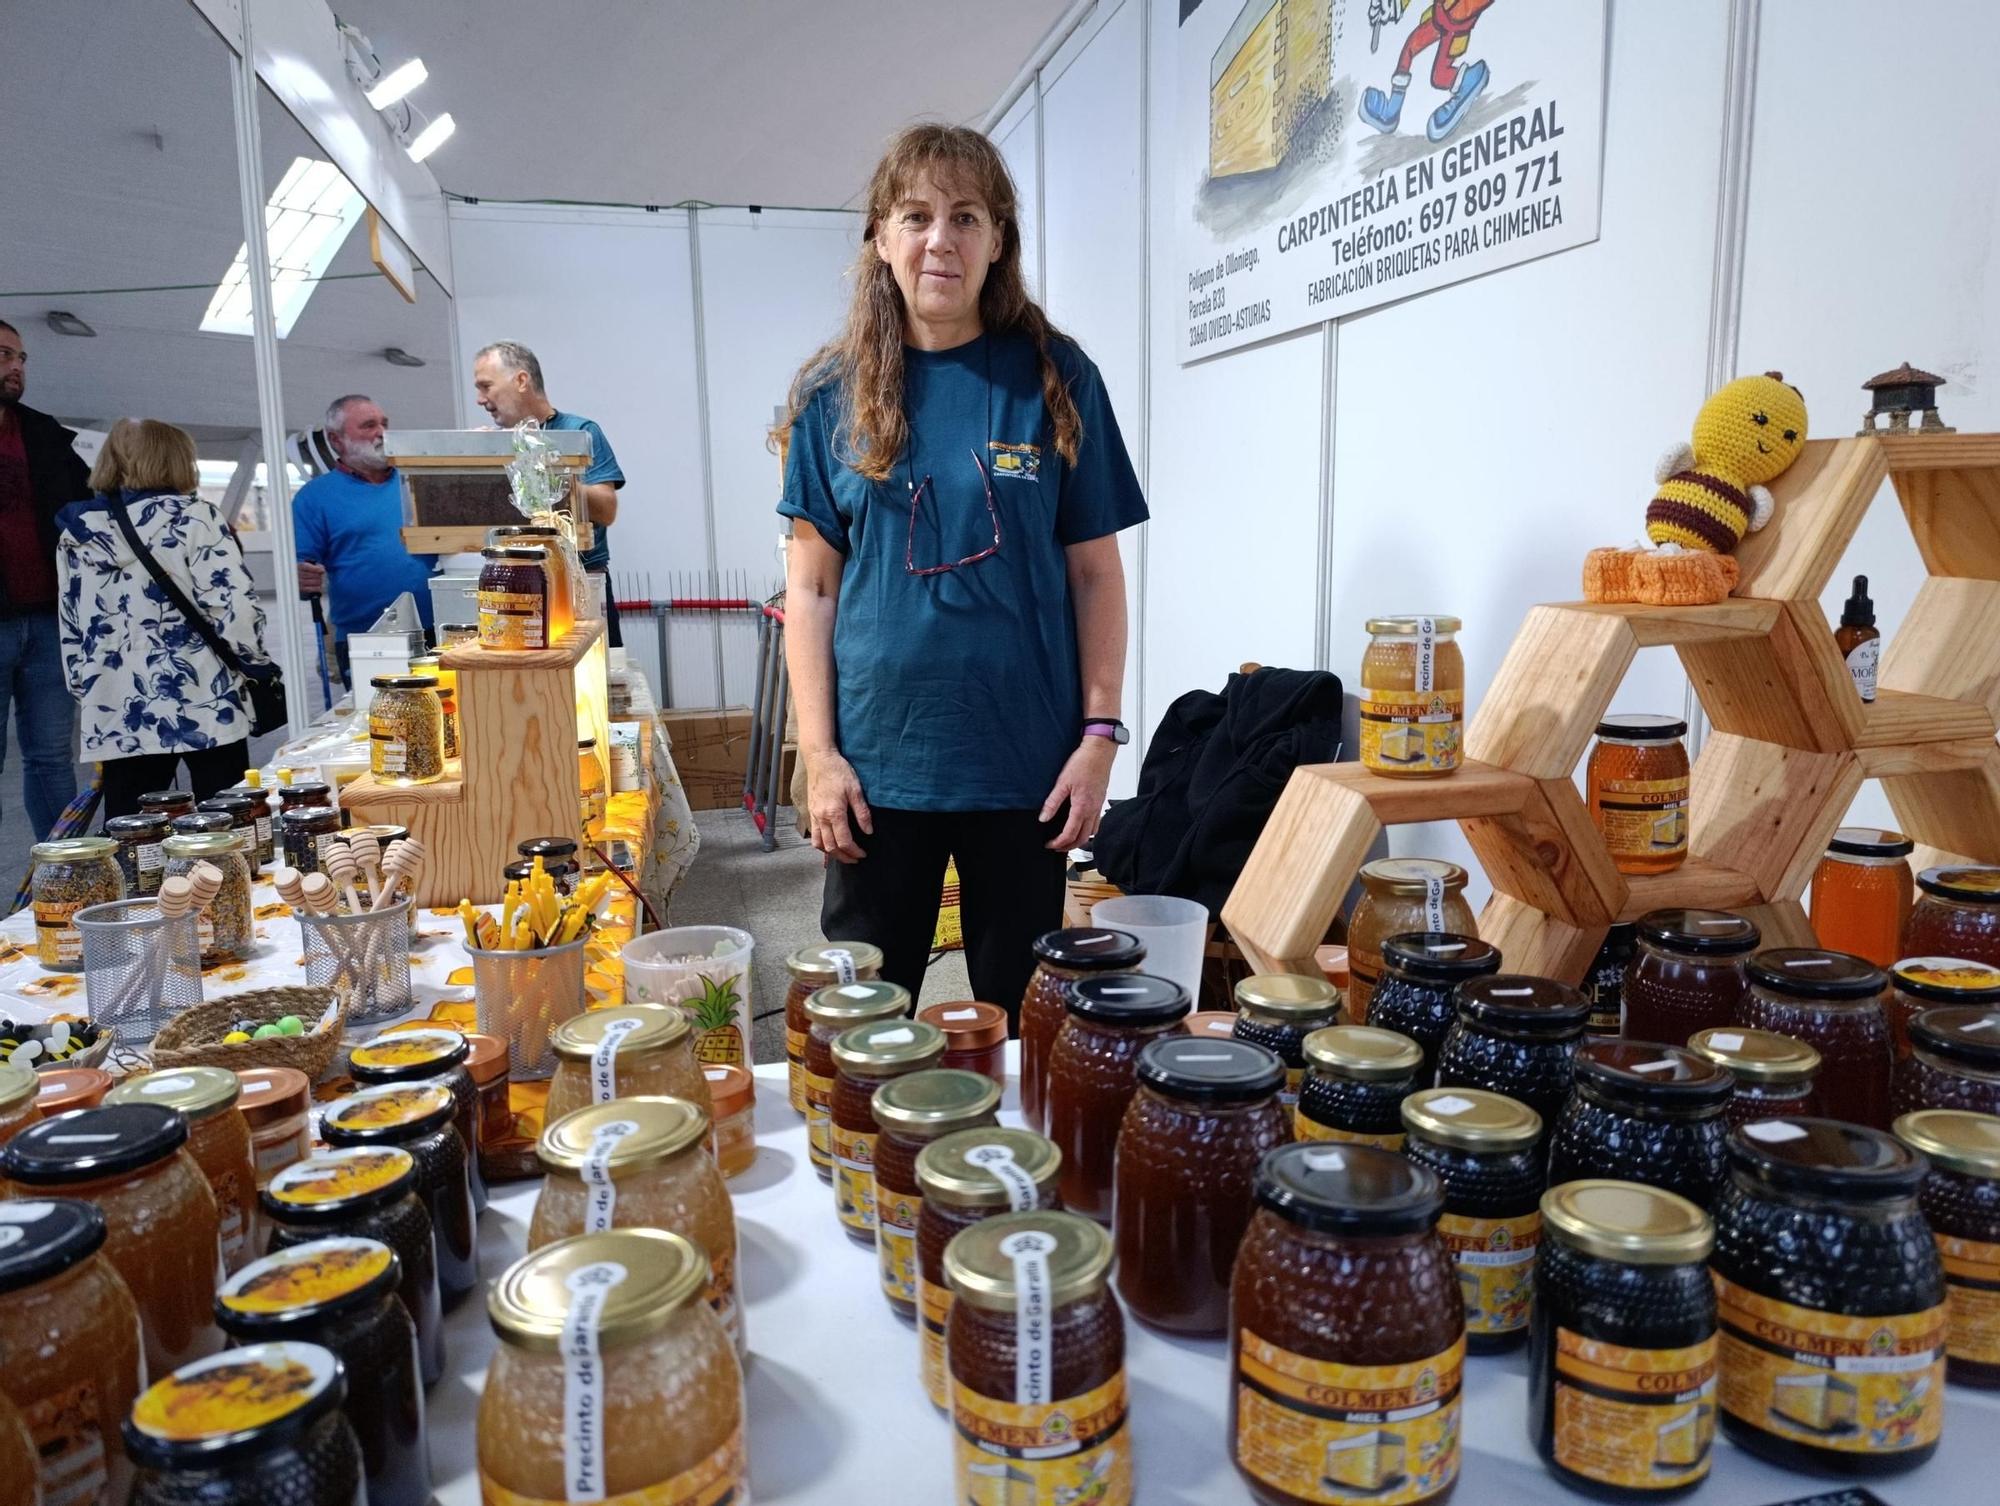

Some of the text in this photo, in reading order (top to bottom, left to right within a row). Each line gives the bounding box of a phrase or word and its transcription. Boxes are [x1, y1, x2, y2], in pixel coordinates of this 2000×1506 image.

[1278, 100, 1564, 253] CARPINTERÍA EN GENERAL
[1332, 150, 1562, 266] Teléfono: 697 809 771
[1308, 195, 1562, 306] FABRICACIÓN BRIQUETAS PARA CHIMENEA
[1216, 260, 1224, 280] de
[1189, 287, 1225, 320] Parcela B33
[1189, 299, 1271, 347] 33660 OVIEDO-ASTURIAS
[1424, 637, 1432, 650] de
[1419, 654, 1431, 691] recinto
[1372, 703, 1428, 716] COLMEN
[1391, 716, 1409, 724] MIEL
[1430, 897, 1438, 910] de
[597, 1072, 610, 1089] de
[597, 1190, 611, 1211] de
[1026, 1318, 1042, 1341] de
[1756, 1320, 1865, 1356] COLMEN
[1794, 1352, 1829, 1367] MIEL
[577, 1363, 595, 1386] de
[1306, 1384, 1412, 1409] COLMEN
[1345, 1412, 1382, 1423] MIEL
[575, 1395, 595, 1494] Precinto
